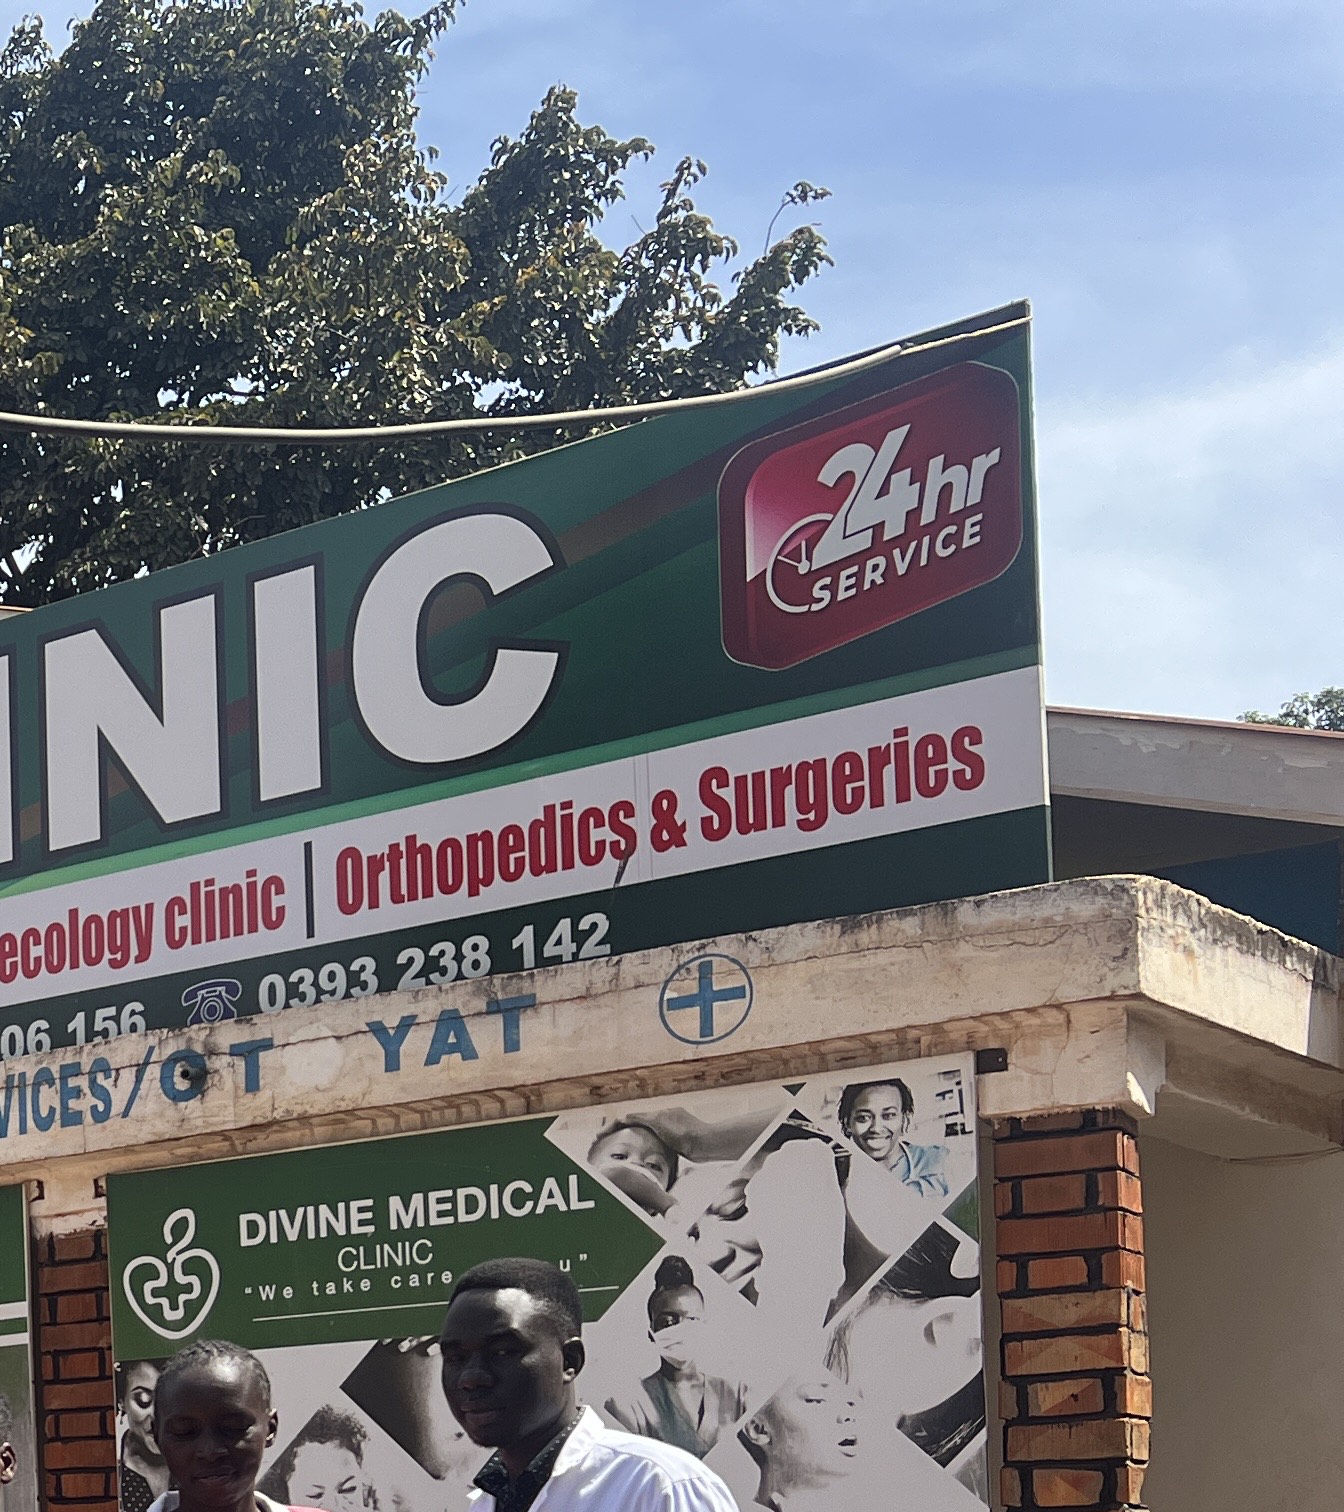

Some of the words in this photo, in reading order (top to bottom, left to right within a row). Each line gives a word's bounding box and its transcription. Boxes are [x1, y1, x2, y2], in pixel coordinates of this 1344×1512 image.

[811, 423, 1001, 571] 24hr
[810, 513, 984, 611] SERVICE
[335, 796, 637, 916] Orthopedics
[651, 789, 688, 853] &
[698, 725, 987, 842] Surgeries
[163, 868, 287, 951] clinic
[257, 956, 380, 1014] 0393
[395, 934, 493, 990] 238
[511, 911, 612, 970] 142
[66, 1001, 147, 1047] 156
[366, 994, 537, 1073] YAT
[239, 1197, 376, 1248] DIVINE
[388, 1173, 596, 1231] MEDICAL
[312, 1277, 372, 1297] take
[390, 1269, 454, 1290] care
[337, 1239, 434, 1273] CLINIC
